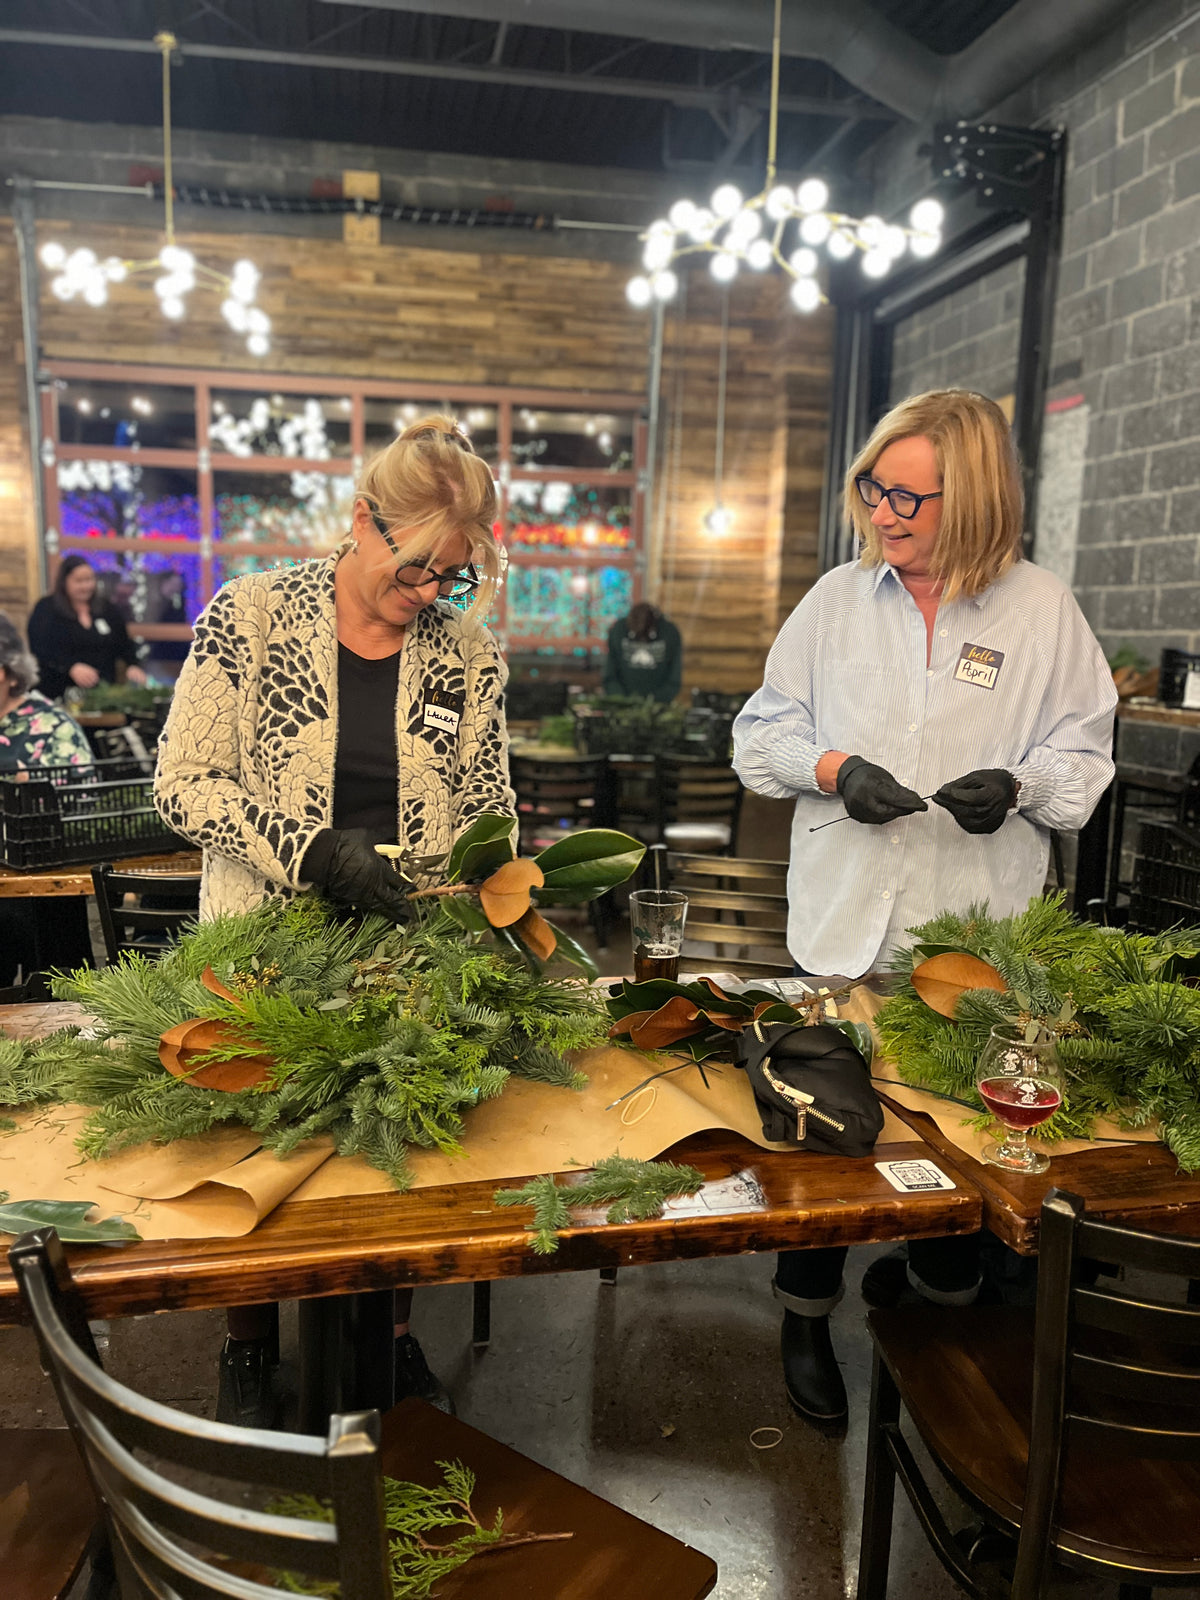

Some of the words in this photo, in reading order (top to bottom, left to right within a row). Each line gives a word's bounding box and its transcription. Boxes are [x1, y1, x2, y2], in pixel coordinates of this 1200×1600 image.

[968, 646, 996, 662] hello
[962, 661, 994, 683] April
[427, 710, 457, 726] LAURA
